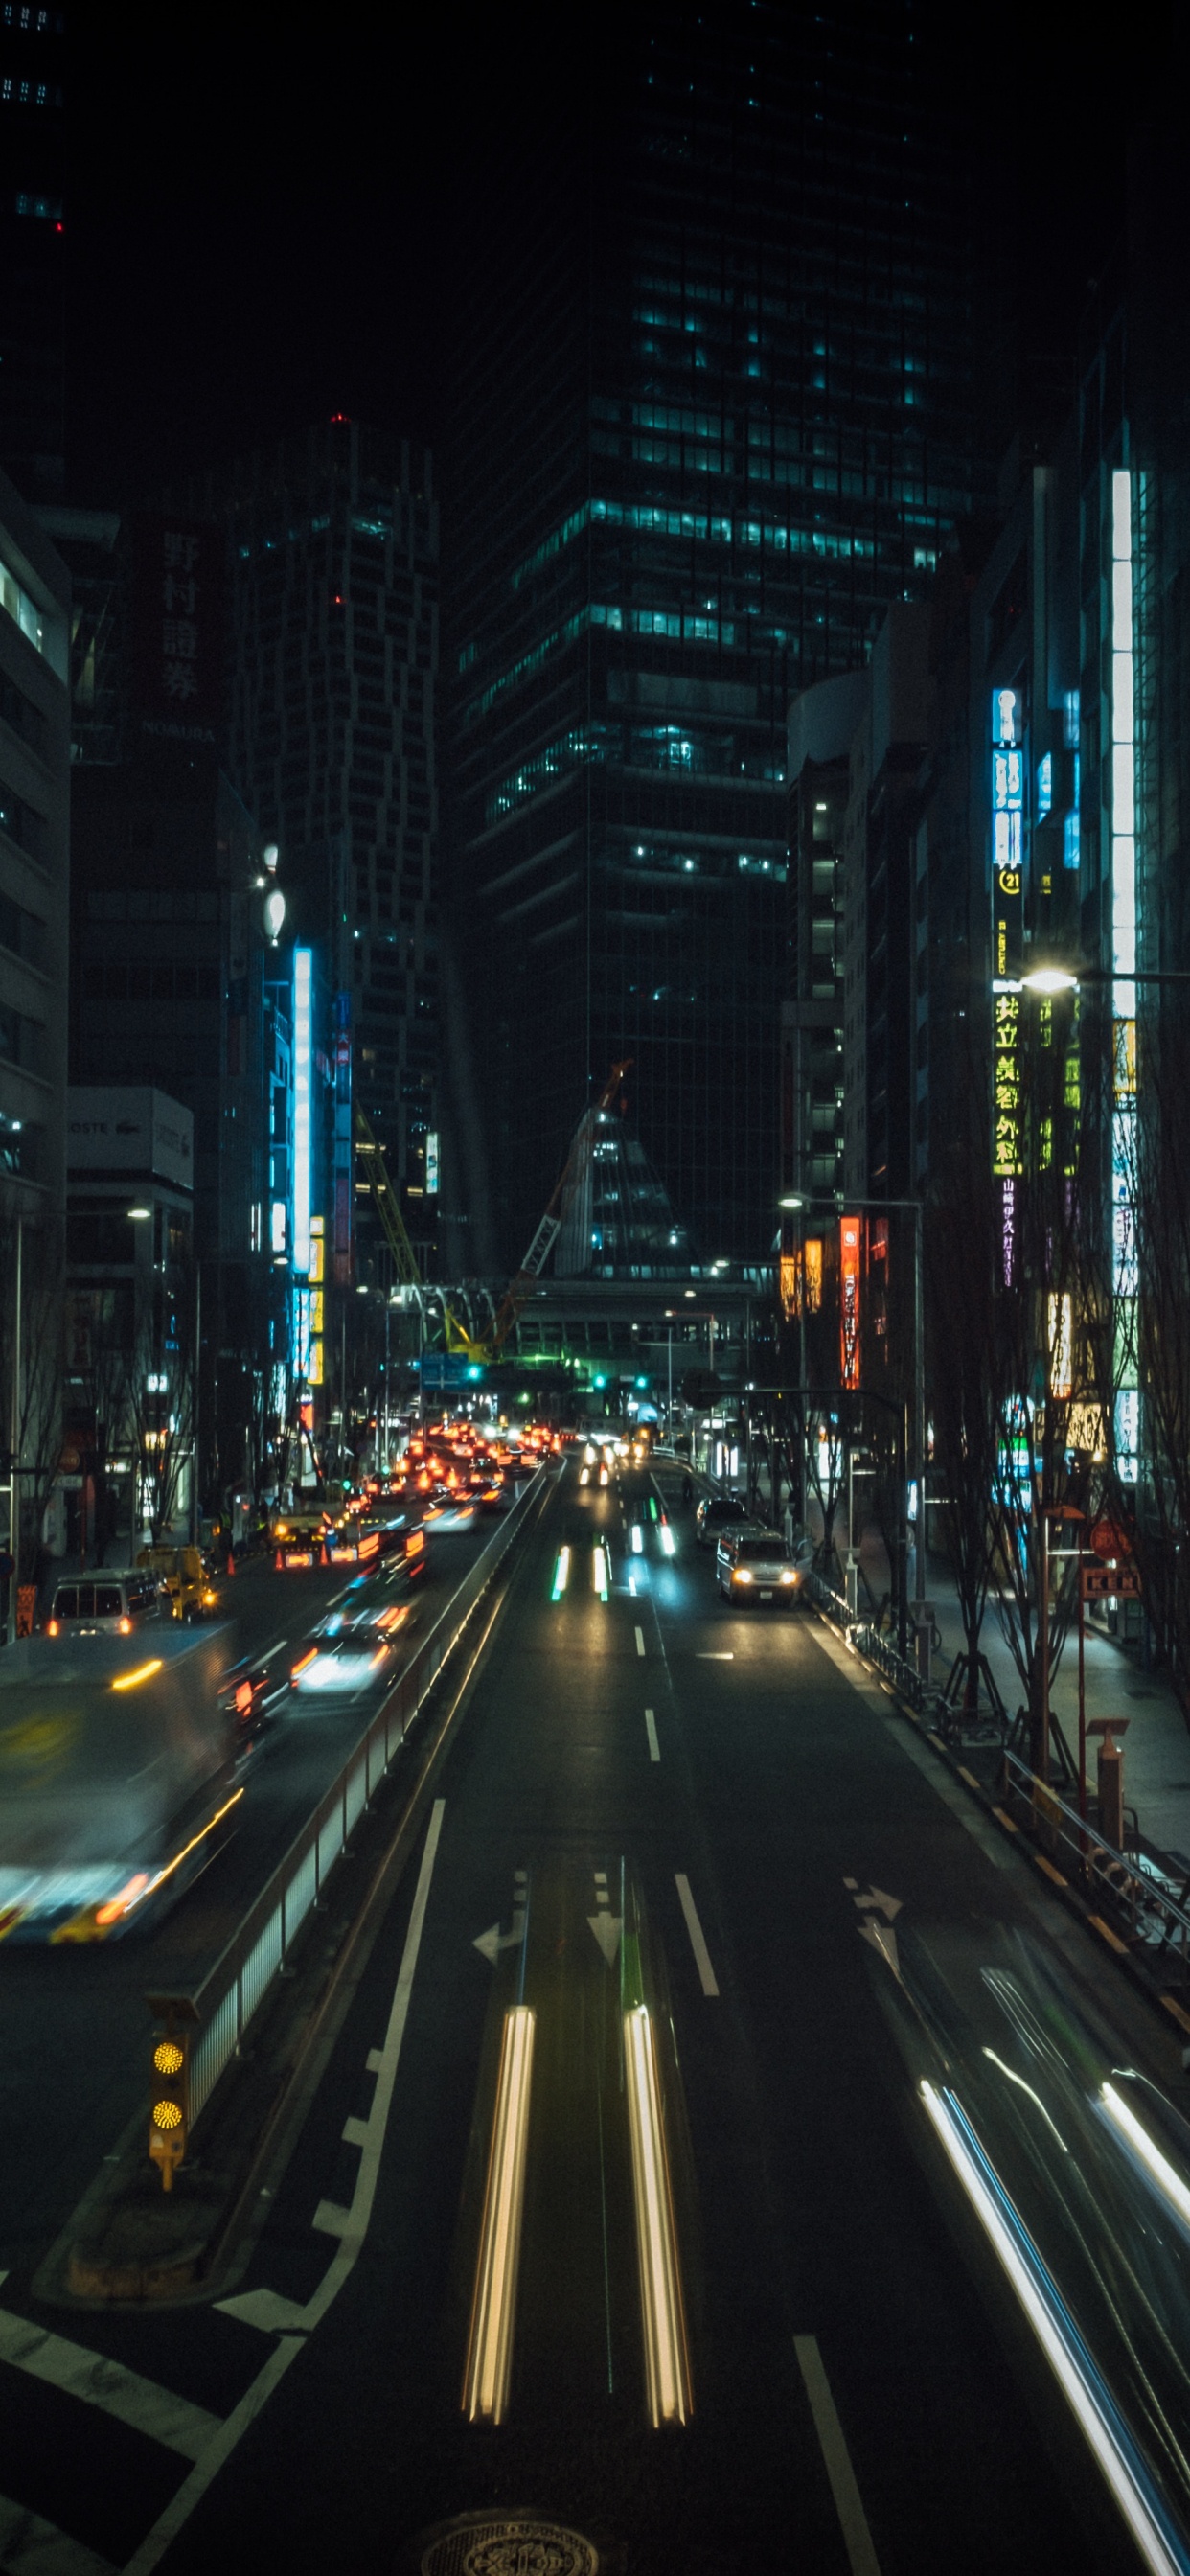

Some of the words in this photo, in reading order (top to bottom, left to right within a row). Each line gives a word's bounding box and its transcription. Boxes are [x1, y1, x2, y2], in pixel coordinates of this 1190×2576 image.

[163, 531, 199, 702] 野村證券
[143, 720, 216, 743] NOMURA
